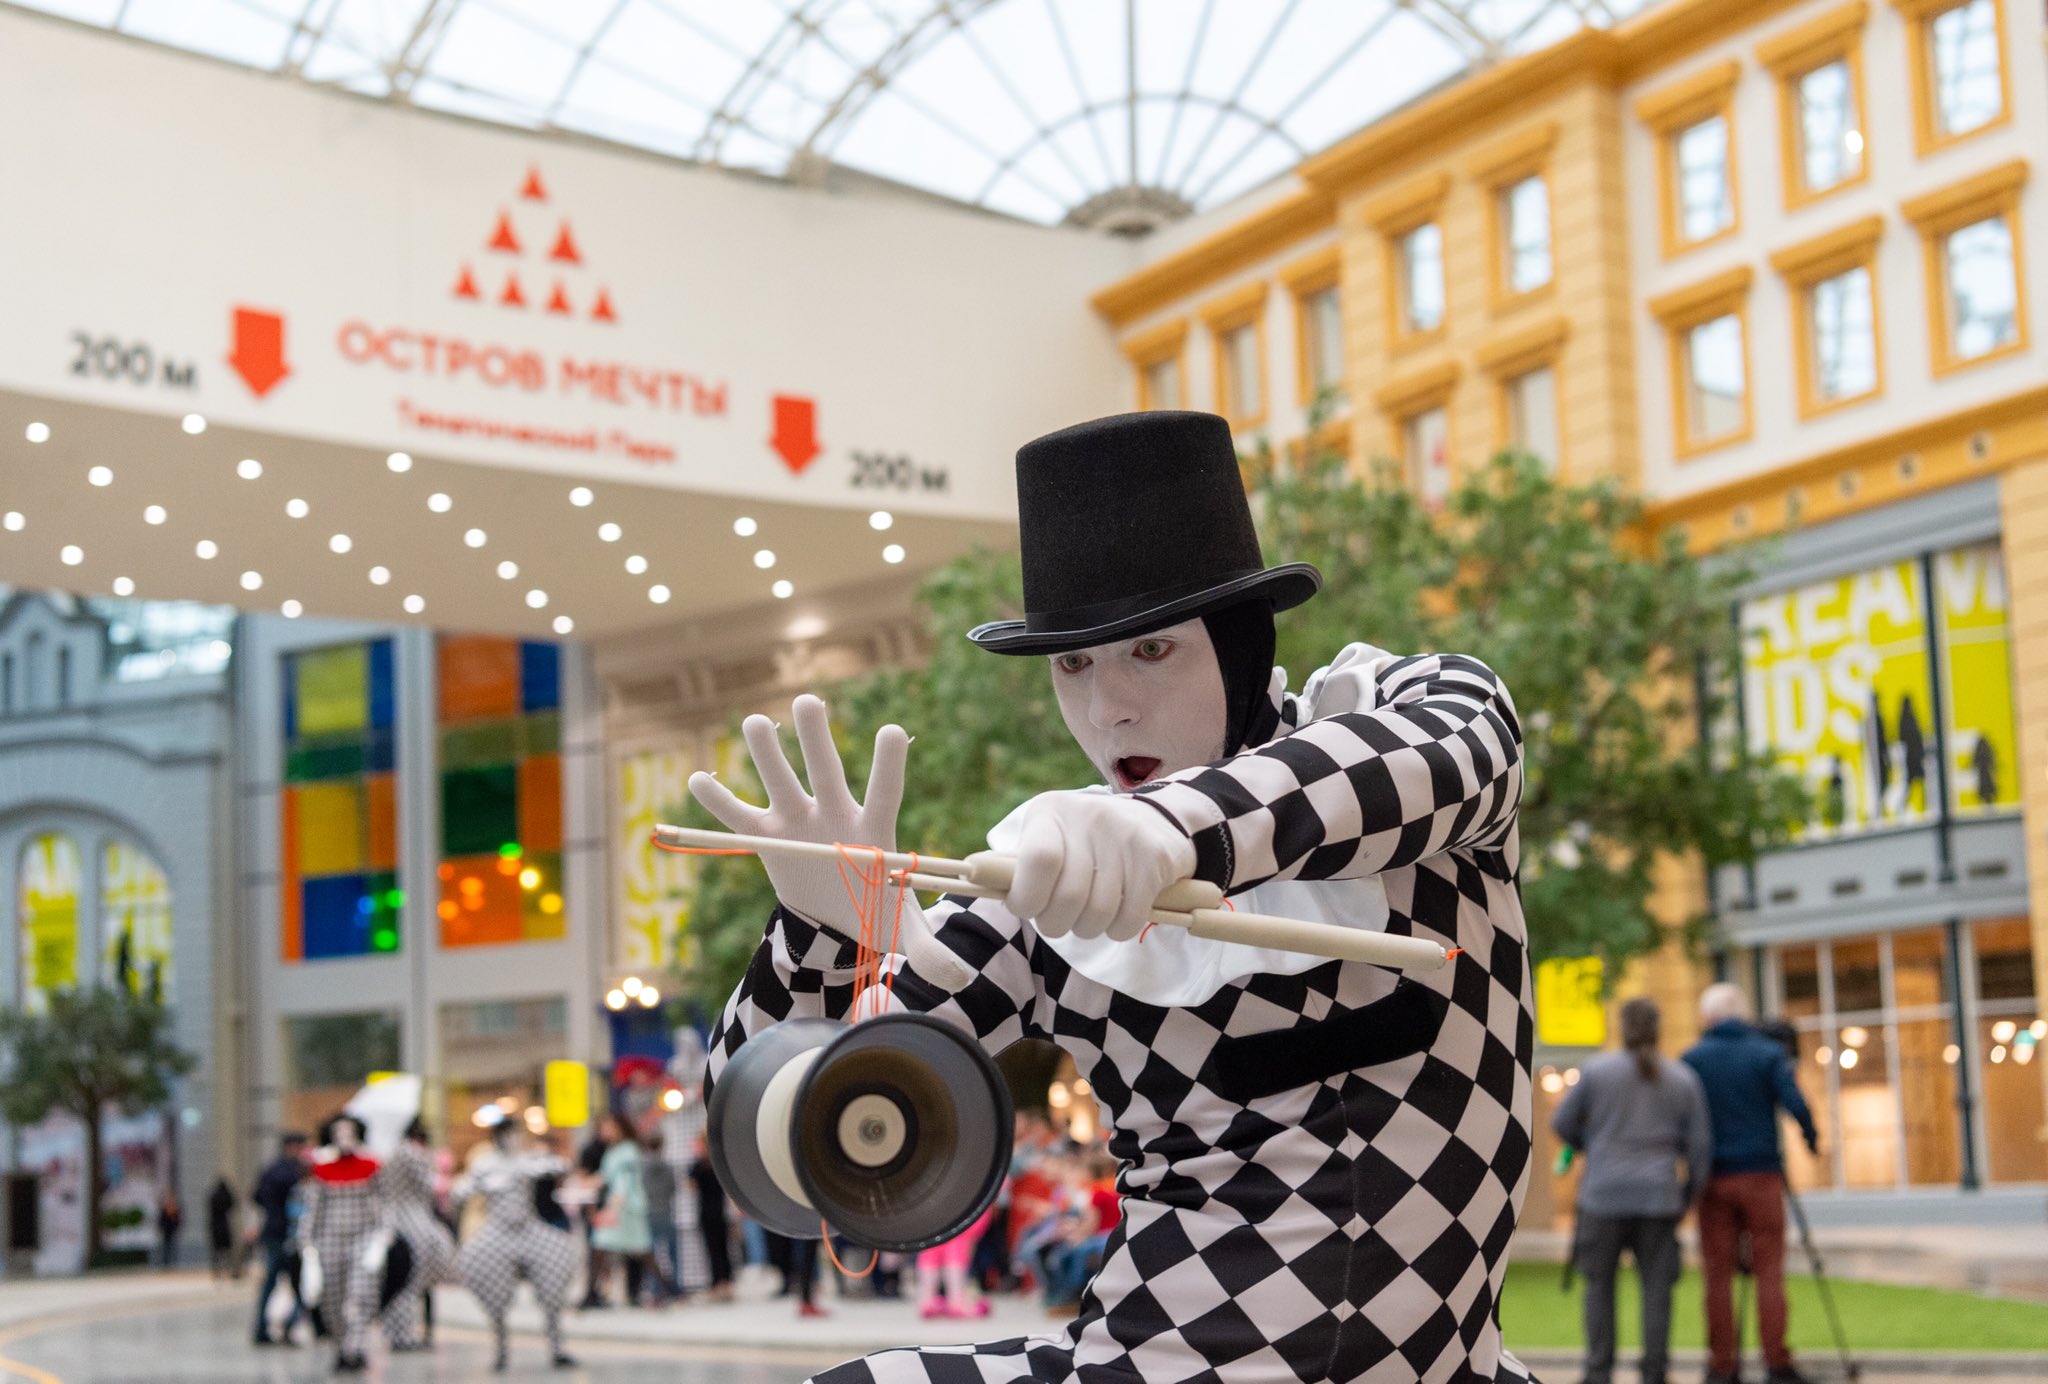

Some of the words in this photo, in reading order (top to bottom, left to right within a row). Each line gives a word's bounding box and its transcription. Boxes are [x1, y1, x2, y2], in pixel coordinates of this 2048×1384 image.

[69, 331, 154, 385] 200
[337, 319, 547, 390] ОСТРОВ
[559, 356, 729, 415] МЕЧТЫ
[847, 449, 914, 492] 200
